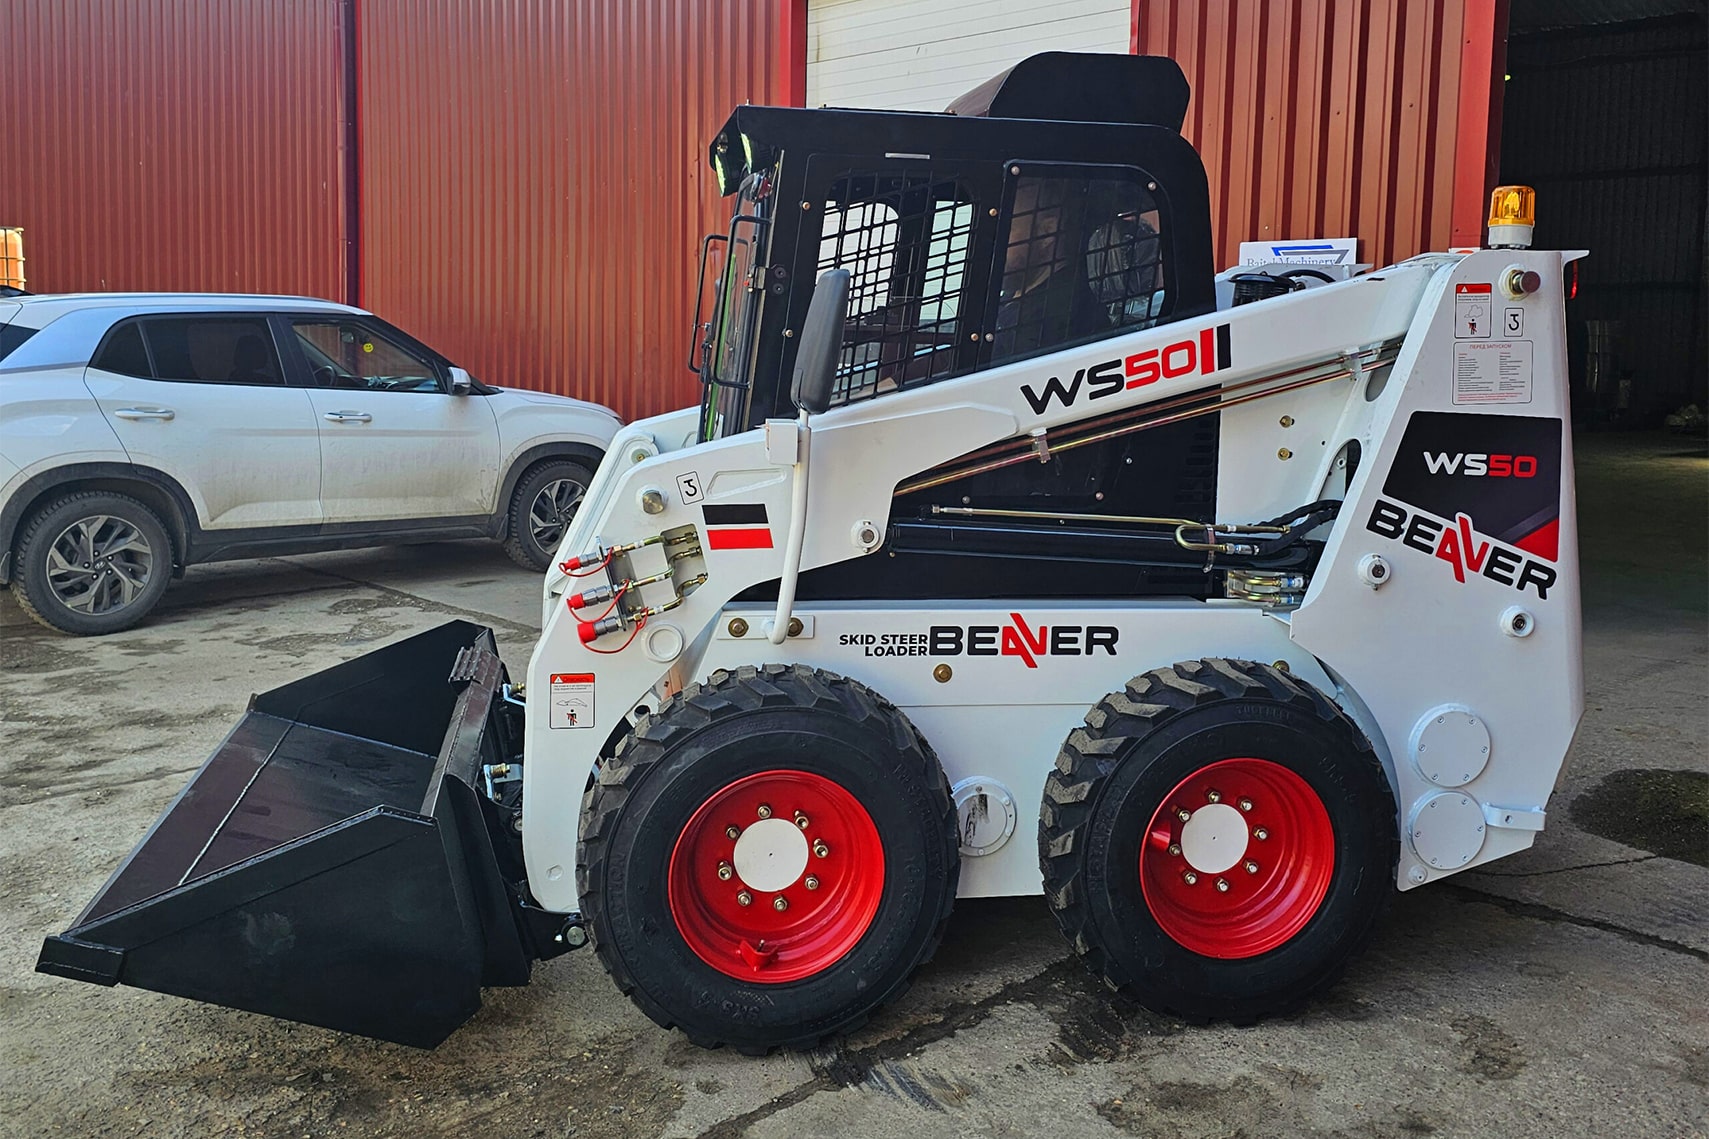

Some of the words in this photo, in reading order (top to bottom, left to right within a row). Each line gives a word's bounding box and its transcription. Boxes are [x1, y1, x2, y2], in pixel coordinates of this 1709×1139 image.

[1423, 451, 1538, 478] WS50
[1366, 499, 1558, 600] BEAVER
[839, 634, 876, 646] SKID
[880, 634, 928, 646] STEER
[864, 645, 928, 657] LOADER
[929, 613, 1120, 668] BEAVER
